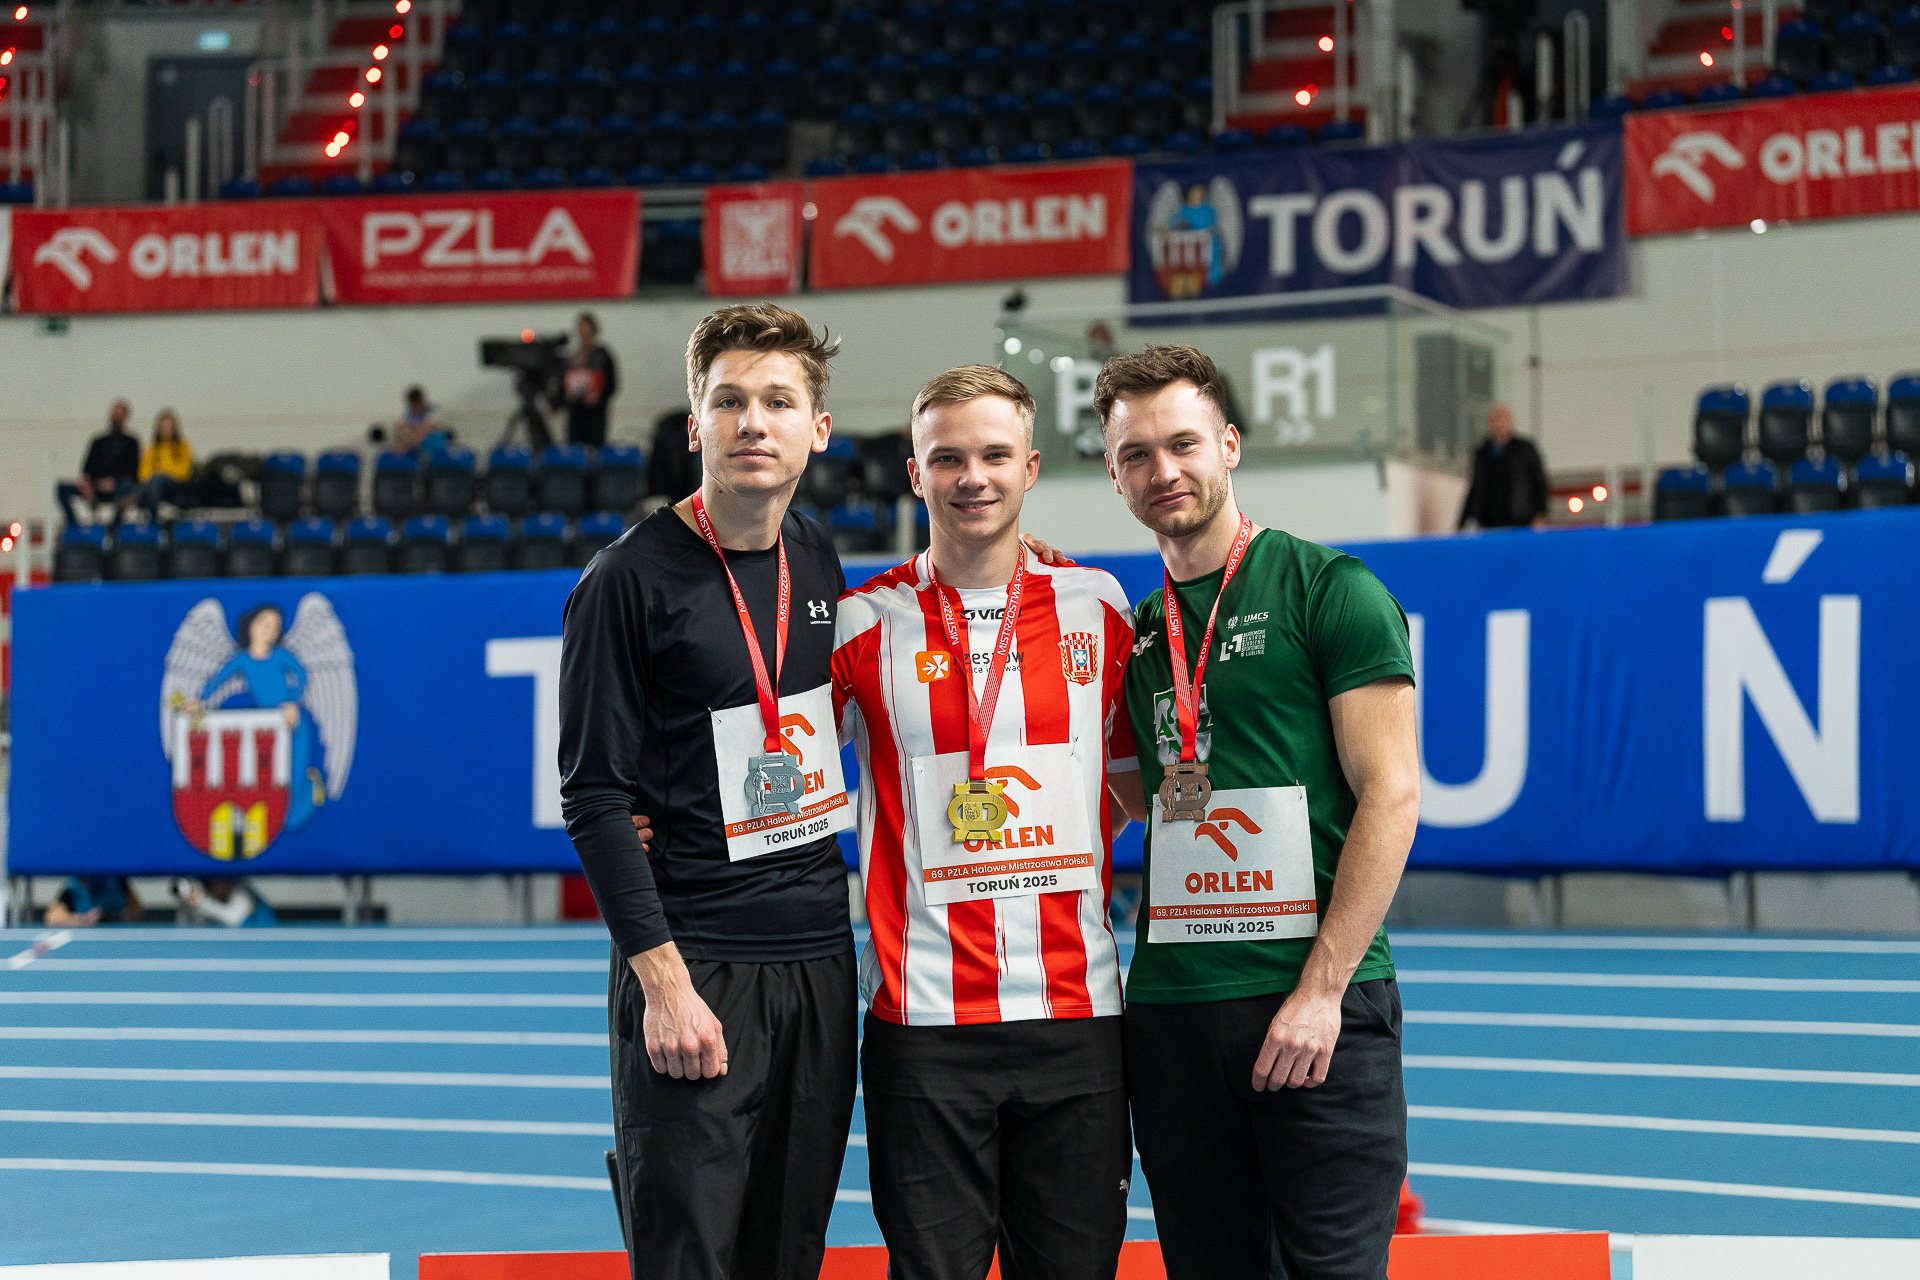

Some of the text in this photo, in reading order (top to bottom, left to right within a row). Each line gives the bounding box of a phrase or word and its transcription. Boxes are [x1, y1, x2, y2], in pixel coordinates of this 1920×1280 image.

[931, 192, 1106, 247] ORLEN
[1248, 140, 1605, 277] TORUŃ
[363, 207, 594, 267] PZLA
[130, 231, 298, 279] ORLEN
[1252, 346, 1335, 424] R1
[997, 583, 1022, 656] MISTRZOSTWA
[1244, 612, 1269, 622] UMCS
[732, 825, 746, 834] 69.
[747, 819, 766, 831] PZLA
[767, 811, 796, 826] Halowe
[830, 795, 845, 809] Polski
[764, 818, 829, 846] TORUŃ 2025
[931, 855, 1088, 879] 69. PZLA Halowe Mistrzostwa Polski
[1185, 870, 1273, 894] ORLEN
[967, 874, 1058, 894] TORUŃ 2025
[1156, 902, 1310, 917] 69. PZLA Halowe Mistrzostwa Polski
[1185, 920, 1275, 935] TORUŃ 2025
